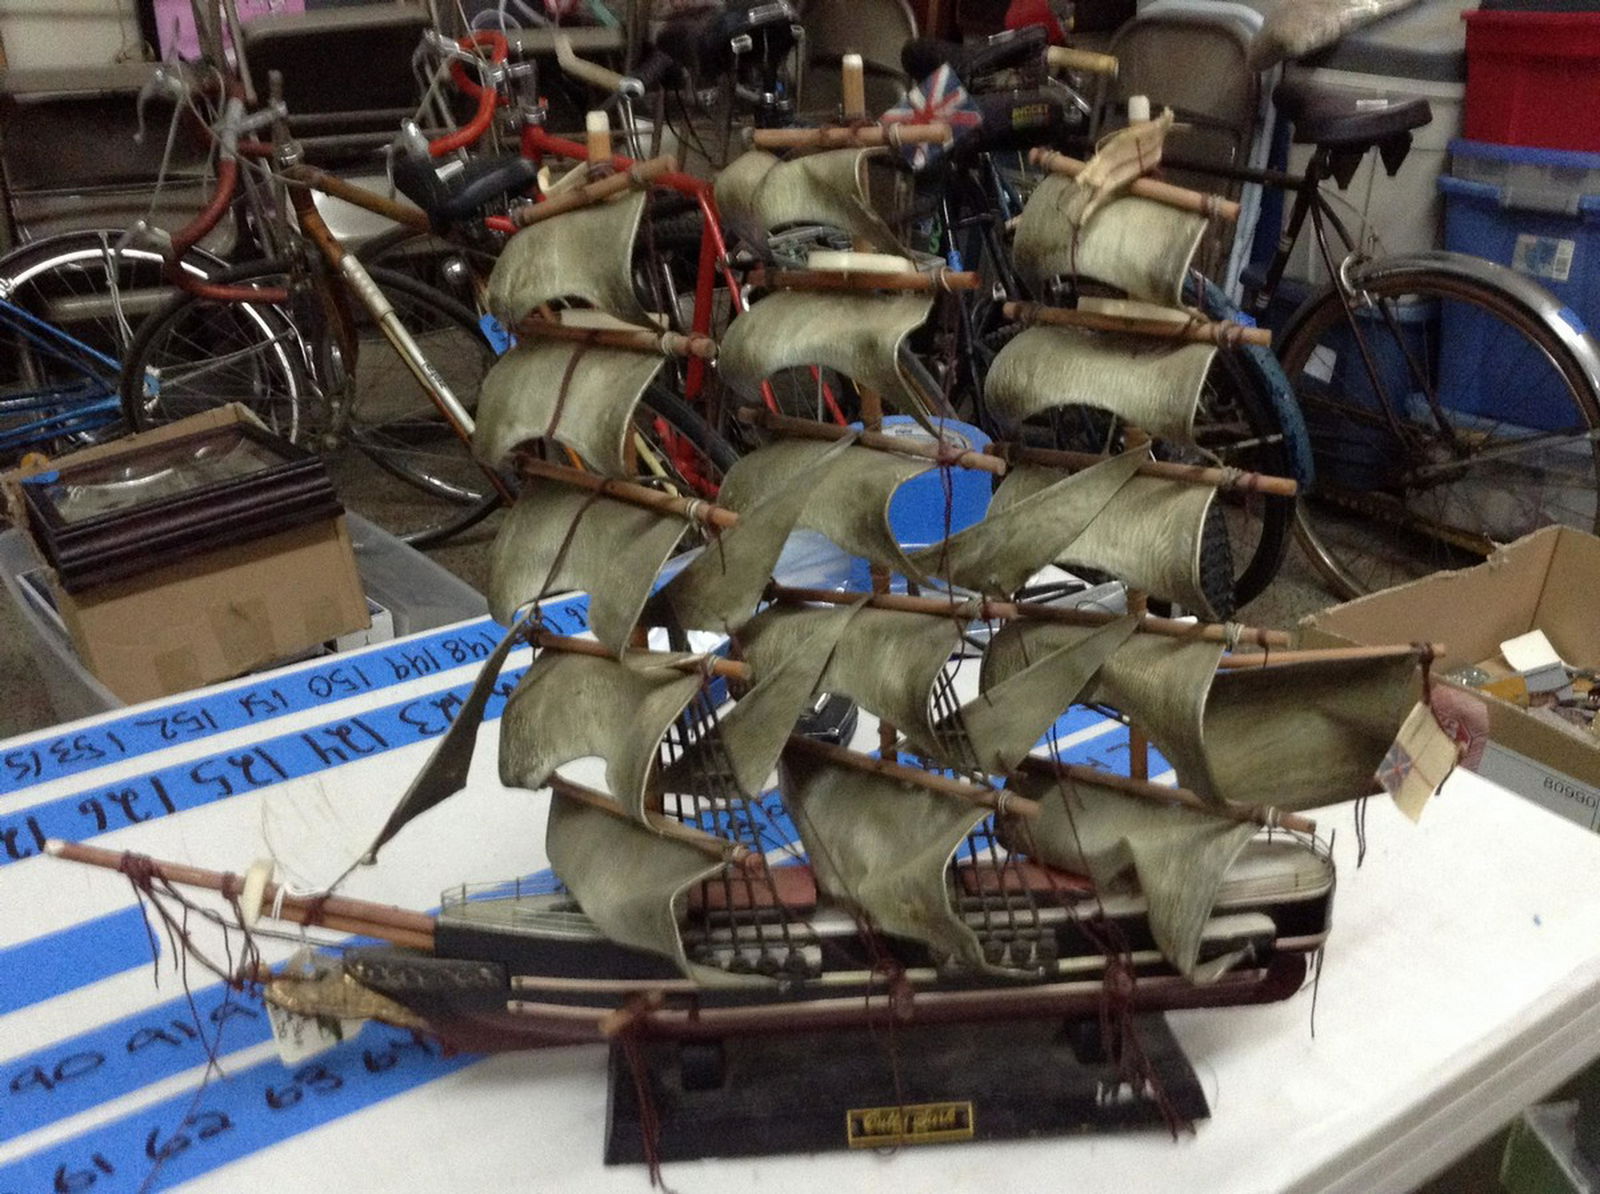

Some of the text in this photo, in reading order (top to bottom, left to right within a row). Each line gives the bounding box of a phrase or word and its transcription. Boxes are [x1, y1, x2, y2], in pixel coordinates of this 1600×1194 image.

[384, 646, 440, 680] 149
[442, 631, 498, 663] 148
[307, 675, 373, 698] 150
[134, 709, 221, 742] 152
[303, 716, 391, 767] 124
[49, 731, 127, 764] 153
[4, 750, 42, 781] 15
[191, 746, 289, 798] 125
[78, 775, 176, 832] 126
[0, 815, 46, 860] 12
[10, 1001, 259, 1094] 90 91 9
